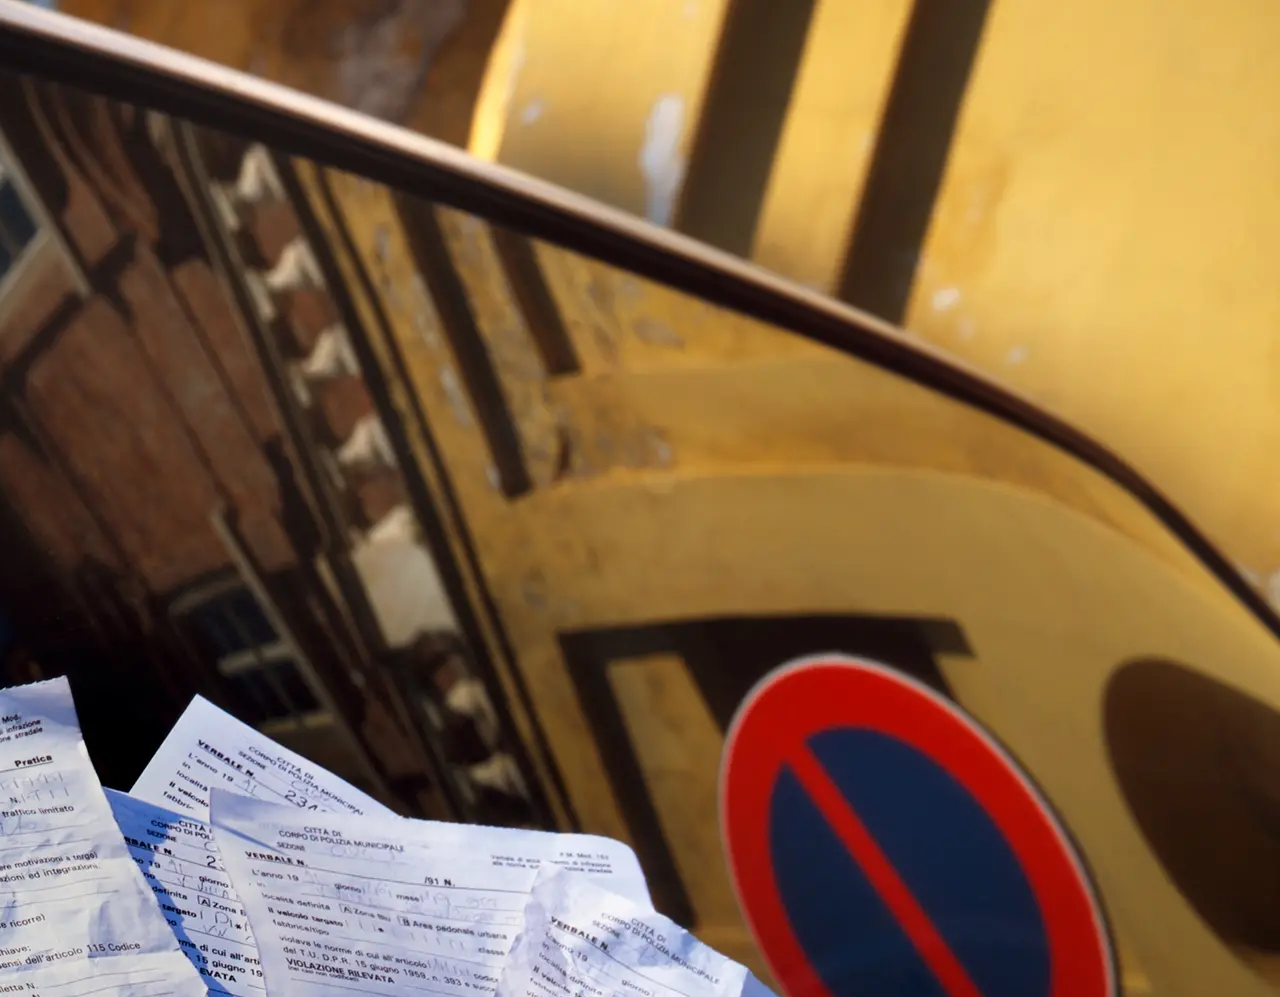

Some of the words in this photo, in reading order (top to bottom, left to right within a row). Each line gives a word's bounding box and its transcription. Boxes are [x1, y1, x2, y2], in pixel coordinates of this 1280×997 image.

[14, 754, 52, 767] Pratica
[198, 739, 242, 771] VERBALE
[245, 770, 256, 779] N.
[238, 751, 266, 771] SEZIONE
[248, 746, 277, 765] CORPO
[287, 767, 320, 789] POLIZIA
[2, 808, 36, 817] traffico
[39, 805, 74, 814] limitato
[151, 820, 181, 833] CORPO
[183, 827, 193, 835] DI
[279, 830, 309, 839] CORPO
[320, 836, 353, 846] POLIZIA
[354, 841, 404, 852] MUNICIPALE
[245, 852, 294, 866] VERBALE
[424, 877, 440, 885] /91
[199, 876, 229, 888] giorno
[9, 914, 45, 928] ricorre)
[162, 904, 196, 918] targato
[550, 916, 598, 945] VERBALE
[600, 942, 612, 953] N.
[25, 946, 83, 965] dell'articolo
[87, 944, 106, 953] 115
[108, 941, 141, 952] Codice
[286, 958, 345, 975] VIOLAZIONE
[348, 968, 395, 984] RILEVATA
[26, 982, 39, 990] N.
